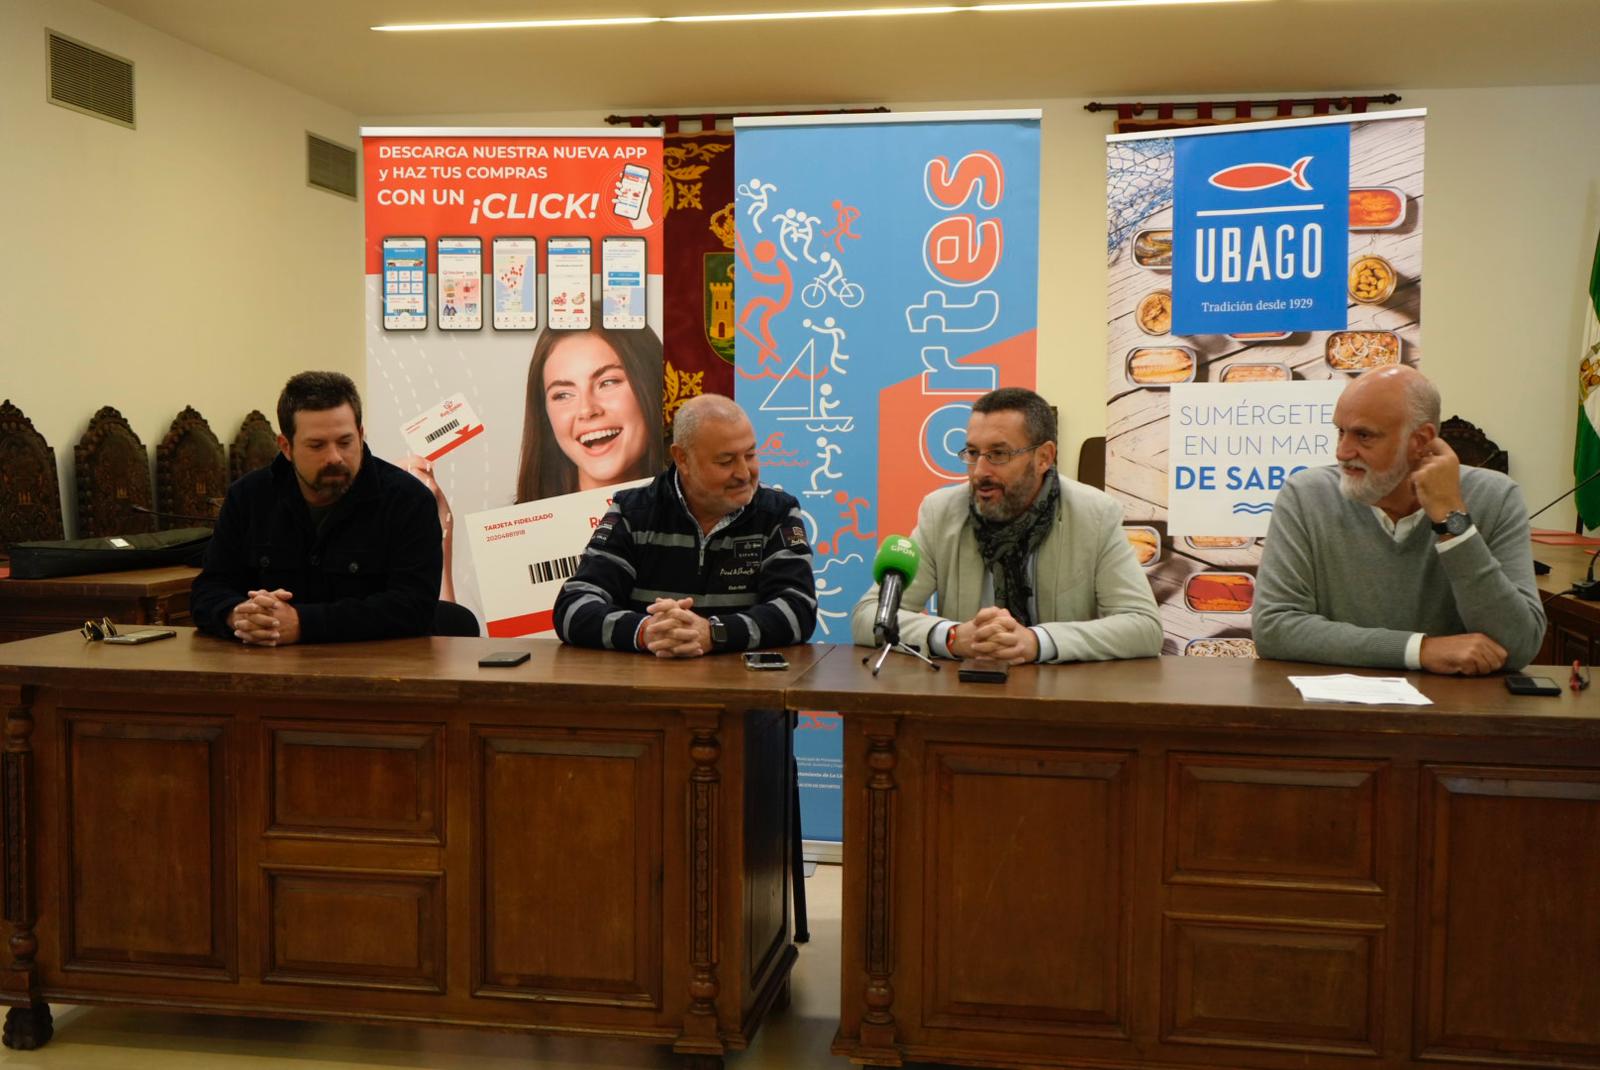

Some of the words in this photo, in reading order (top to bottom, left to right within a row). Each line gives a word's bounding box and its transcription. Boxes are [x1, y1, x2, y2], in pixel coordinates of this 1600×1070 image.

[379, 146, 466, 159] DESCARGA
[473, 146, 549, 159] NUESTRA
[553, 146, 610, 159] NUEVA
[613, 147, 647, 159] APP
[379, 169, 389, 181] y
[393, 166, 426, 179] HAZ
[430, 166, 462, 179] TUS
[466, 166, 548, 179] COMPRAS
[377, 189, 425, 205] CON
[432, 189, 465, 205] UN
[469, 193, 600, 224] ¡CLICK!
[1195, 223, 1323, 283] UBAGO
[1201, 300, 1253, 312] Tradición
[1256, 299, 1286, 311] desde
[1289, 298, 1313, 309] 1929
[1180, 399, 1333, 426] SUMÉRGETE
[1185, 436, 1217, 456] EN
[1227, 436, 1261, 456] UN
[1272, 434, 1329, 455] MAR
[1175, 466, 1216, 490] DE
[1225, 466, 1308, 490] SAB
[484, 521, 513, 532] TARJETA
[514, 512, 554, 526] FIDELIZADO
